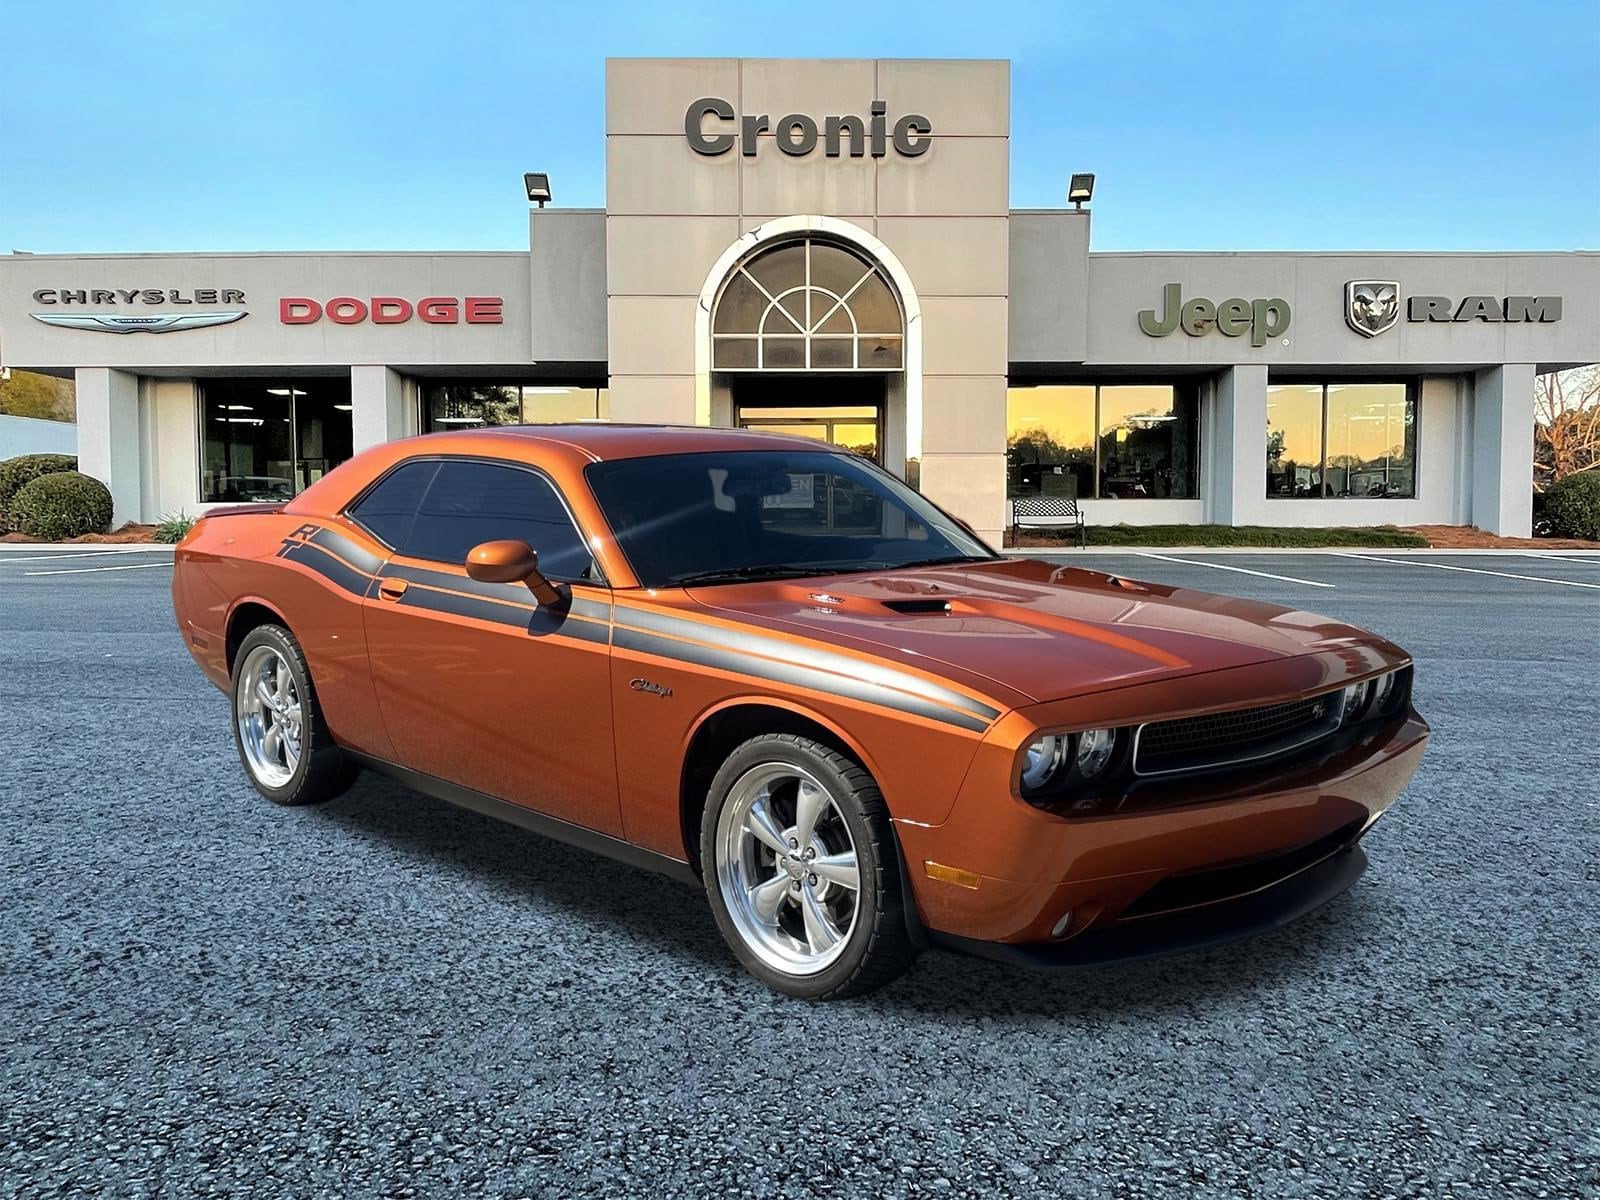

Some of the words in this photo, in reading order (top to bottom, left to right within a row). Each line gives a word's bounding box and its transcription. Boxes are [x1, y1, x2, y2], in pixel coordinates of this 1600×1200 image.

[685, 98, 933, 158] Cronic
[32, 289, 246, 305] CHRYSLER
[279, 297, 504, 325] DODGE
[1407, 296, 1563, 322] RAM
[1138, 283, 1292, 347] Jeep
